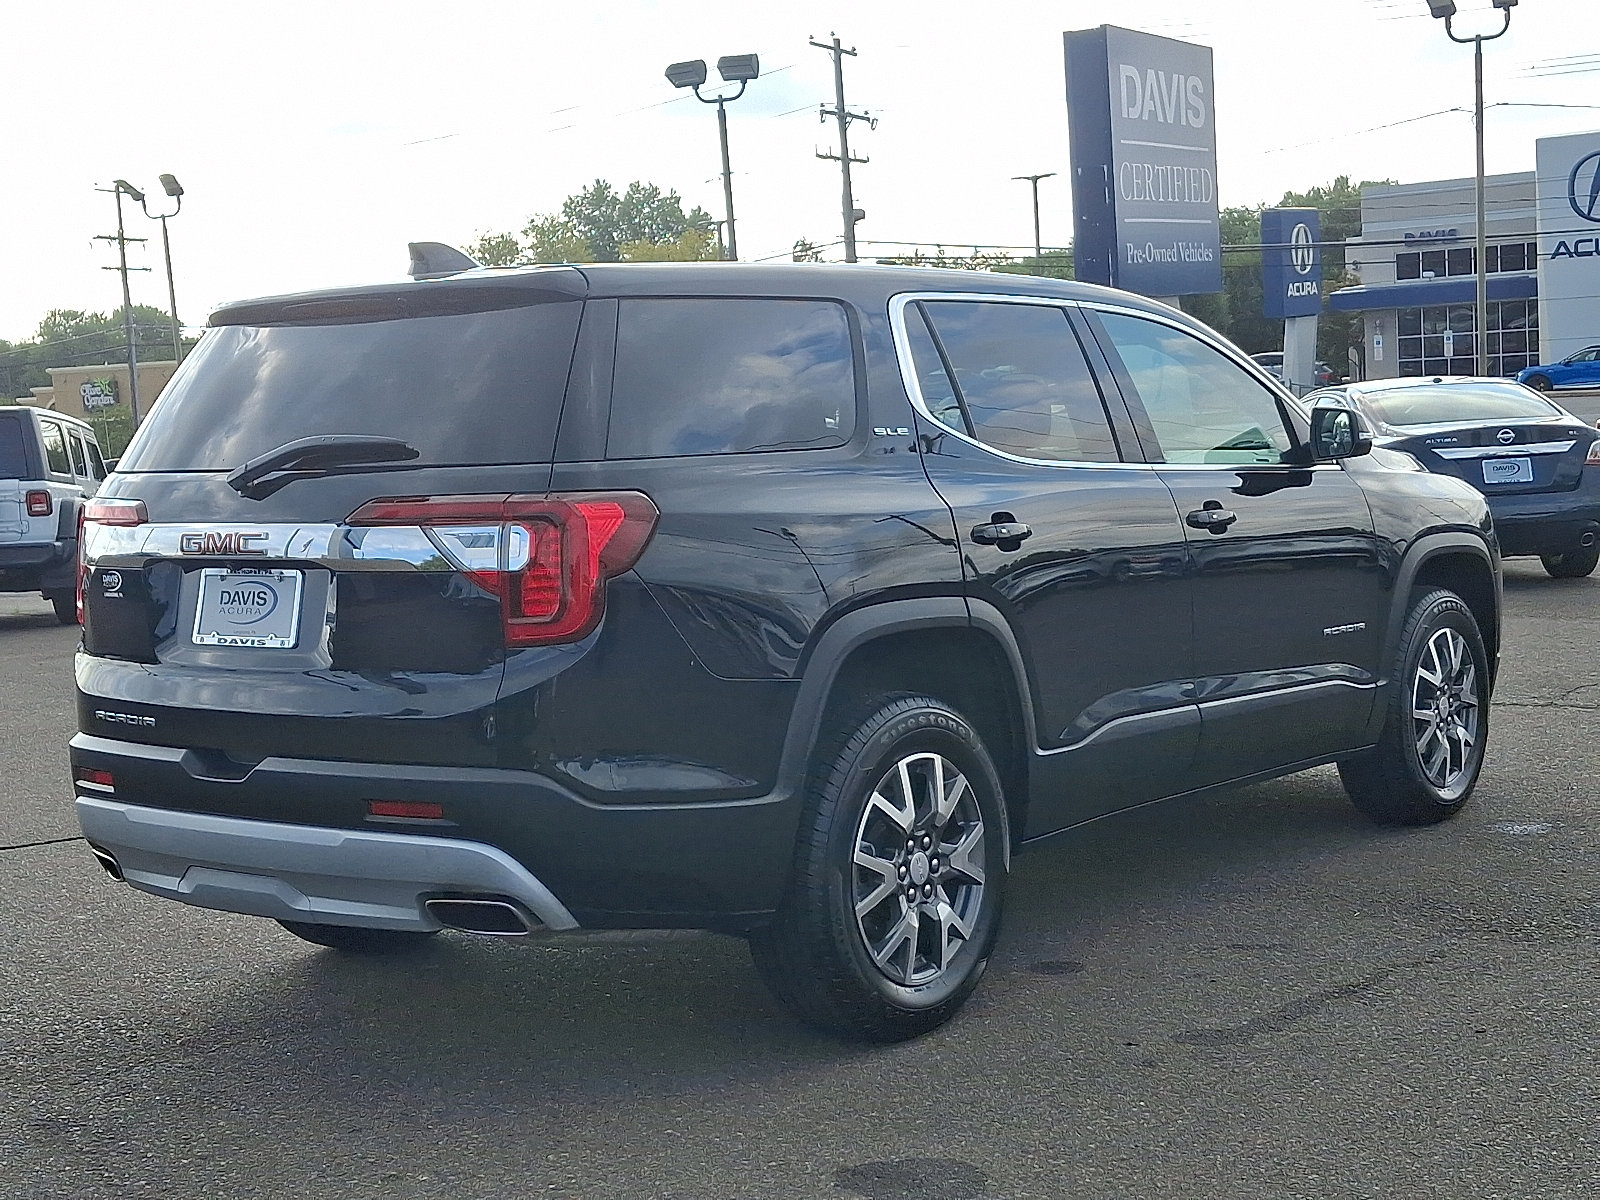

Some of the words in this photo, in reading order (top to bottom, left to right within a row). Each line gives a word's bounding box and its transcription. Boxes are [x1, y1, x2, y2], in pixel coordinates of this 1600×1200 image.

[1119, 64, 1206, 128] DAVIS
[1120, 161, 1213, 203] CERTIFIED
[1126, 242, 1178, 264] Pre-Owned
[1178, 242, 1213, 262] Vehicles
[1287, 281, 1318, 297] ACURA
[873, 427, 910, 436] SLE
[180, 532, 269, 555] GMC
[220, 590, 268, 607] DAVIS
[218, 606, 262, 615] ACURA
[1323, 622, 1366, 636] ACADIA
[216, 637, 267, 646] DAVIS
[95, 710, 156, 726] ACADIA
